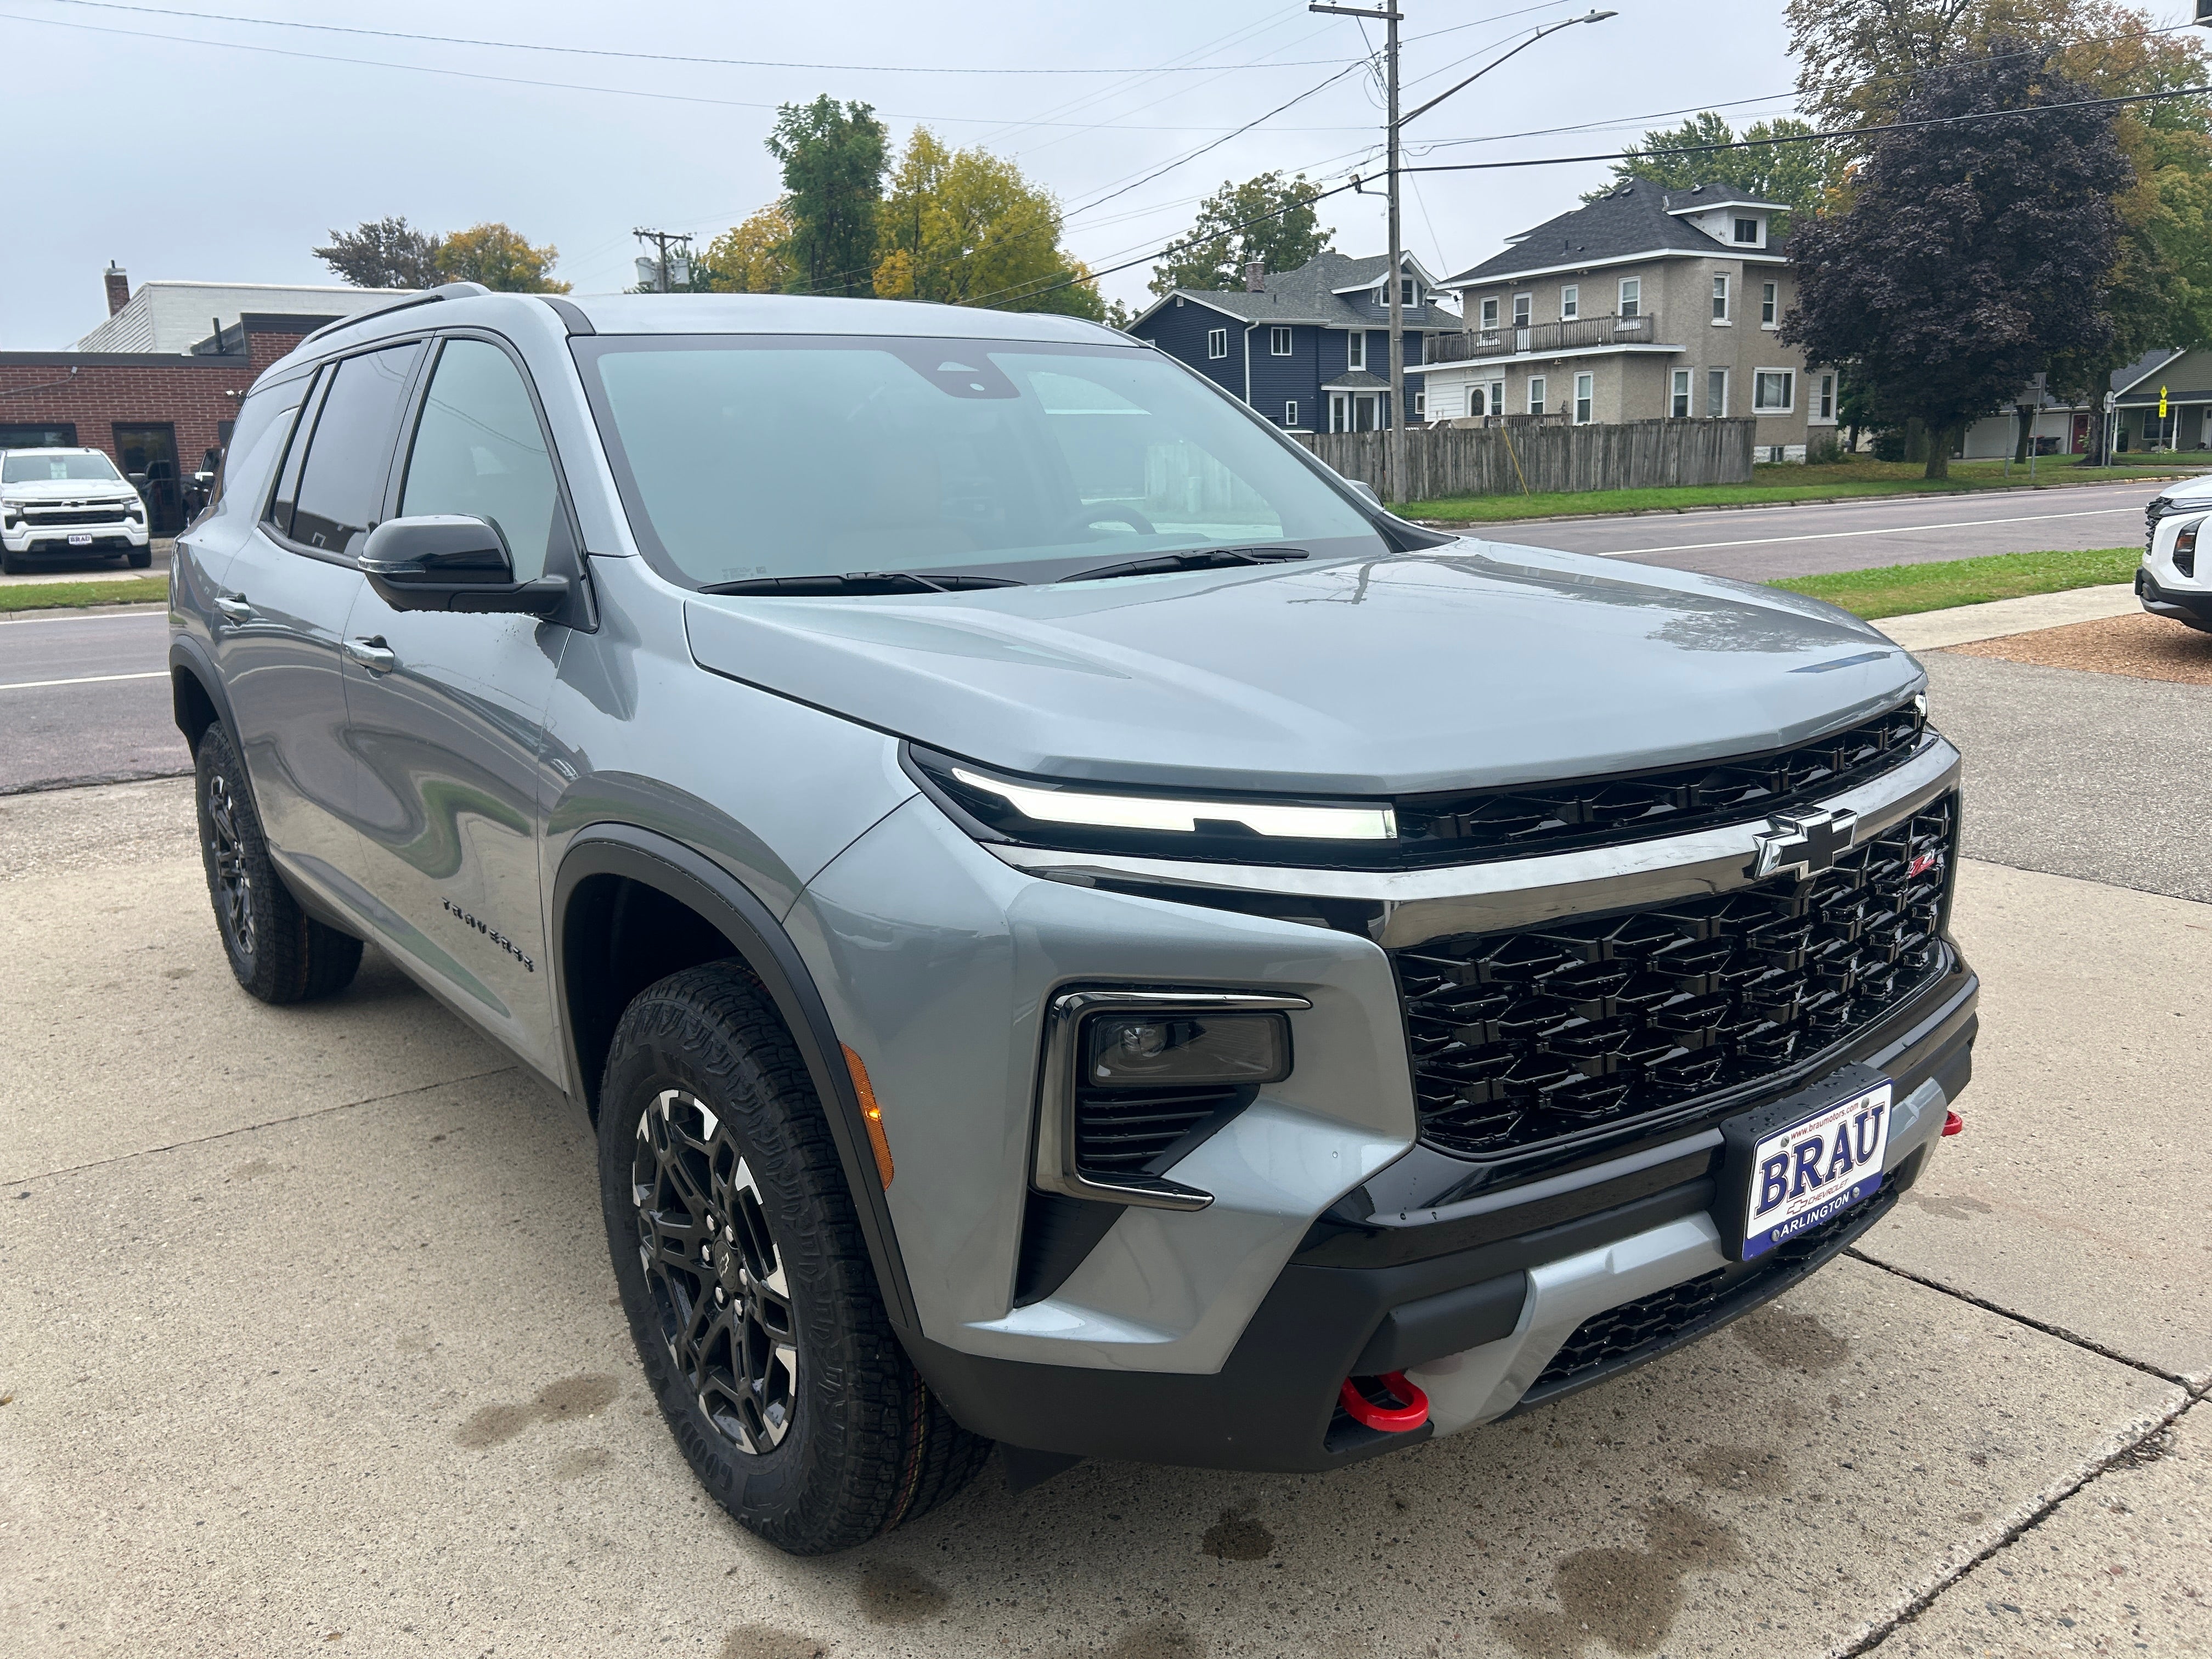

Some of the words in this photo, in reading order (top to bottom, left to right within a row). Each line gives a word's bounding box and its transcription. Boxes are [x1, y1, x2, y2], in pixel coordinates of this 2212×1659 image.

[441, 897, 534, 972] TRAVERSE
[1791, 1102, 1859, 1140] www.braumotors.com
[1754, 1102, 1885, 1219] BRAU
[1780, 1191, 1849, 1238] ARLINGTON
[1808, 1178, 1849, 1205] CHEVROLET
